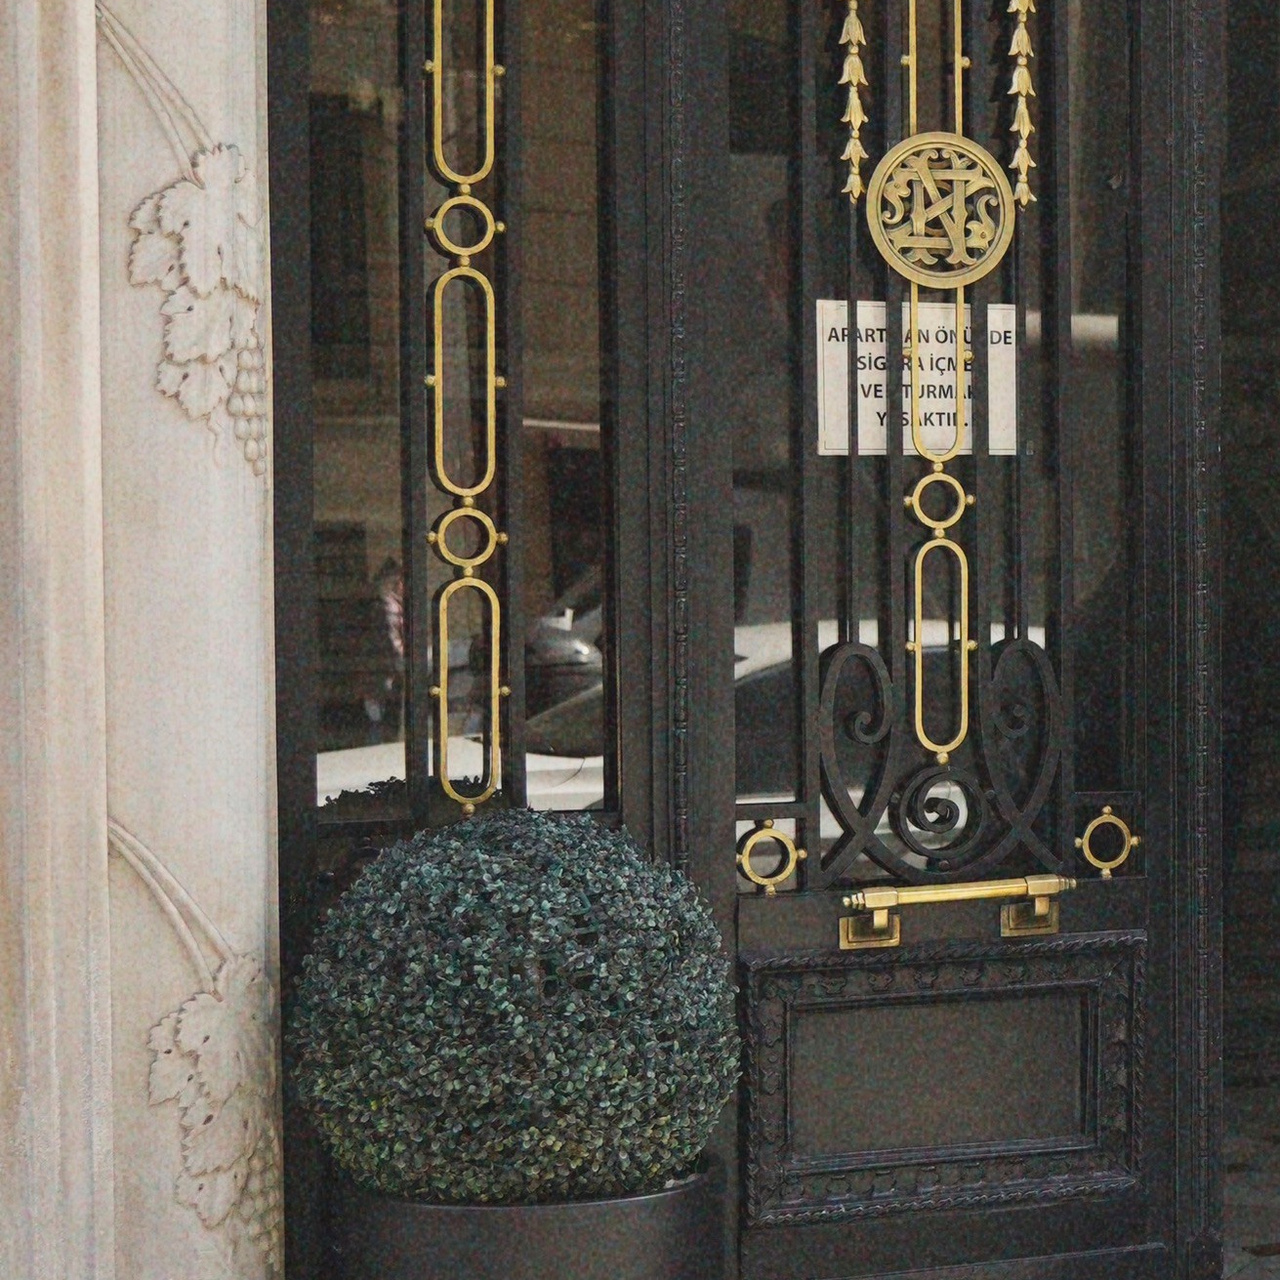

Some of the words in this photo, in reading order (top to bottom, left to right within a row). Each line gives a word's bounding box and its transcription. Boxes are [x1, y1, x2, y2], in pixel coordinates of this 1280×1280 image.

[827, 327, 930, 343] APARTAN
[935, 326, 1012, 345] ÖNÜDE
[857, 352, 925, 371] SİGRA
[860, 384, 883, 399] VE
